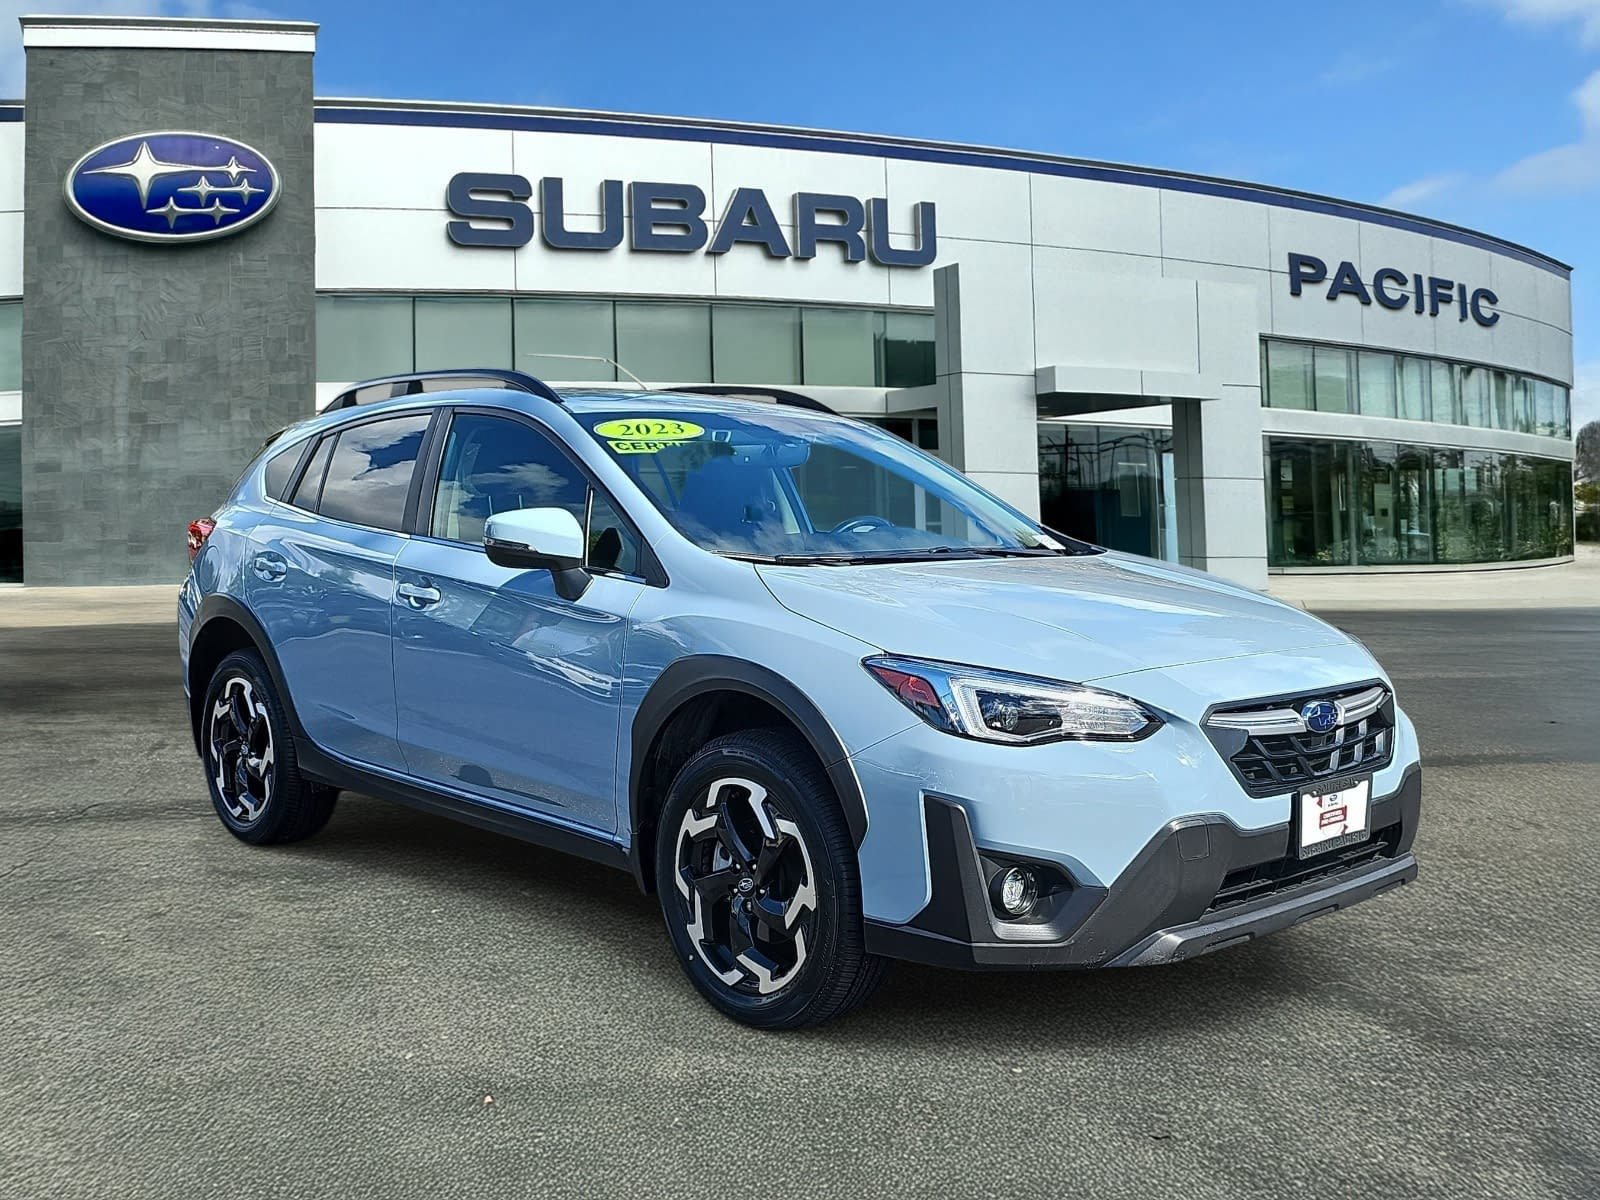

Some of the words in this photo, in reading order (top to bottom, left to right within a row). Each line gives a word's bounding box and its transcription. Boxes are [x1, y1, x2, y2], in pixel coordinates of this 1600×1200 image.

[447, 171, 937, 267] SUBARU
[1288, 252, 1500, 327] PACIFIC
[618, 422, 685, 437] 2023
